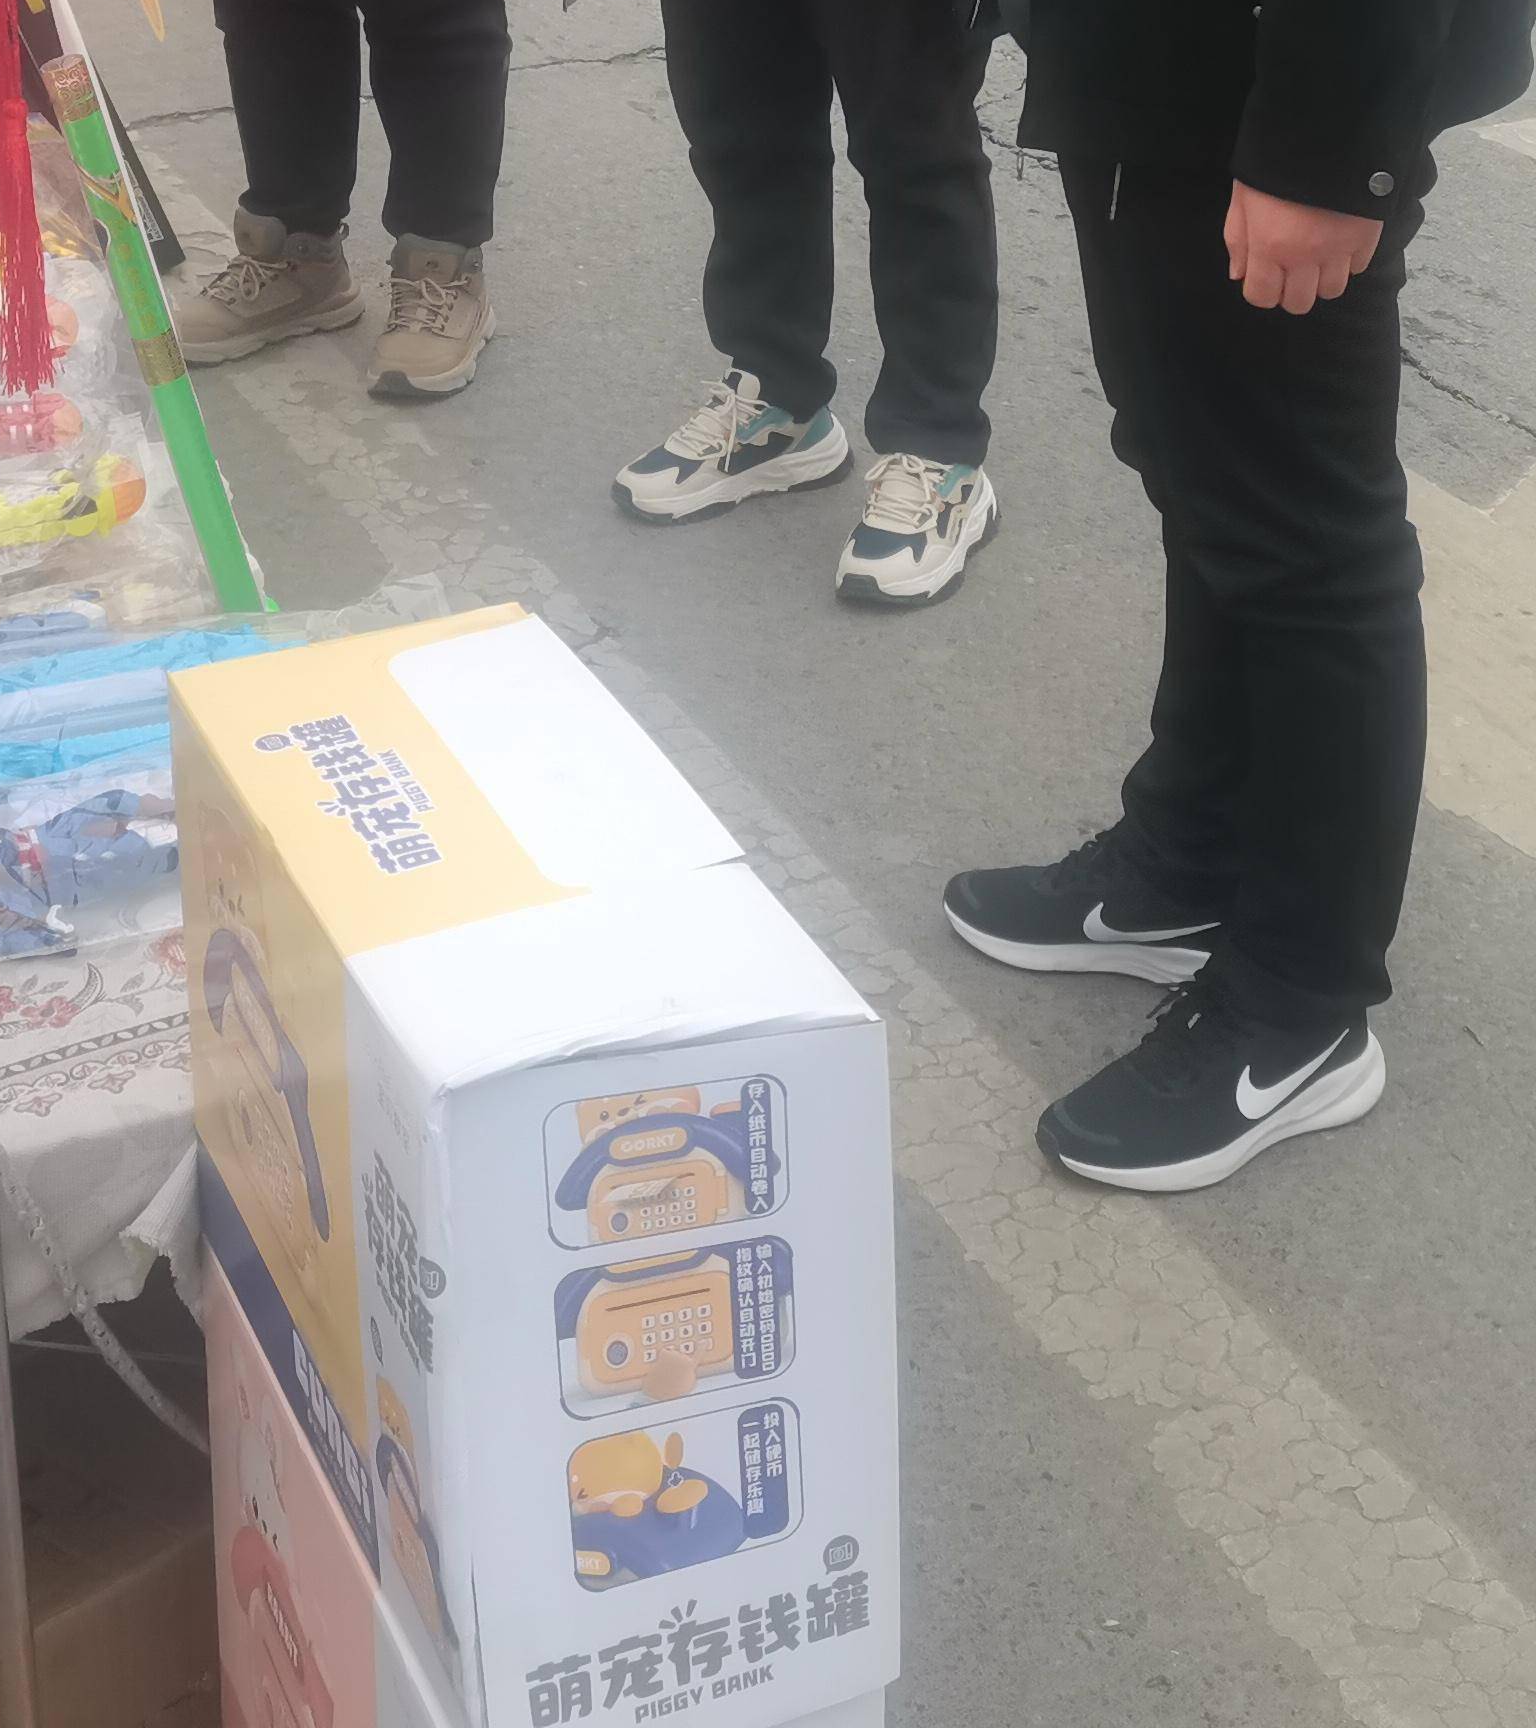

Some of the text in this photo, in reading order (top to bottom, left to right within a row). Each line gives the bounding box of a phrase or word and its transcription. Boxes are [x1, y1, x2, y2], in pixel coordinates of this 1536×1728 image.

[525, 1570, 871, 1728] 萌宠存钱罐
[634, 1663, 775, 1724] PIGGY BANK
